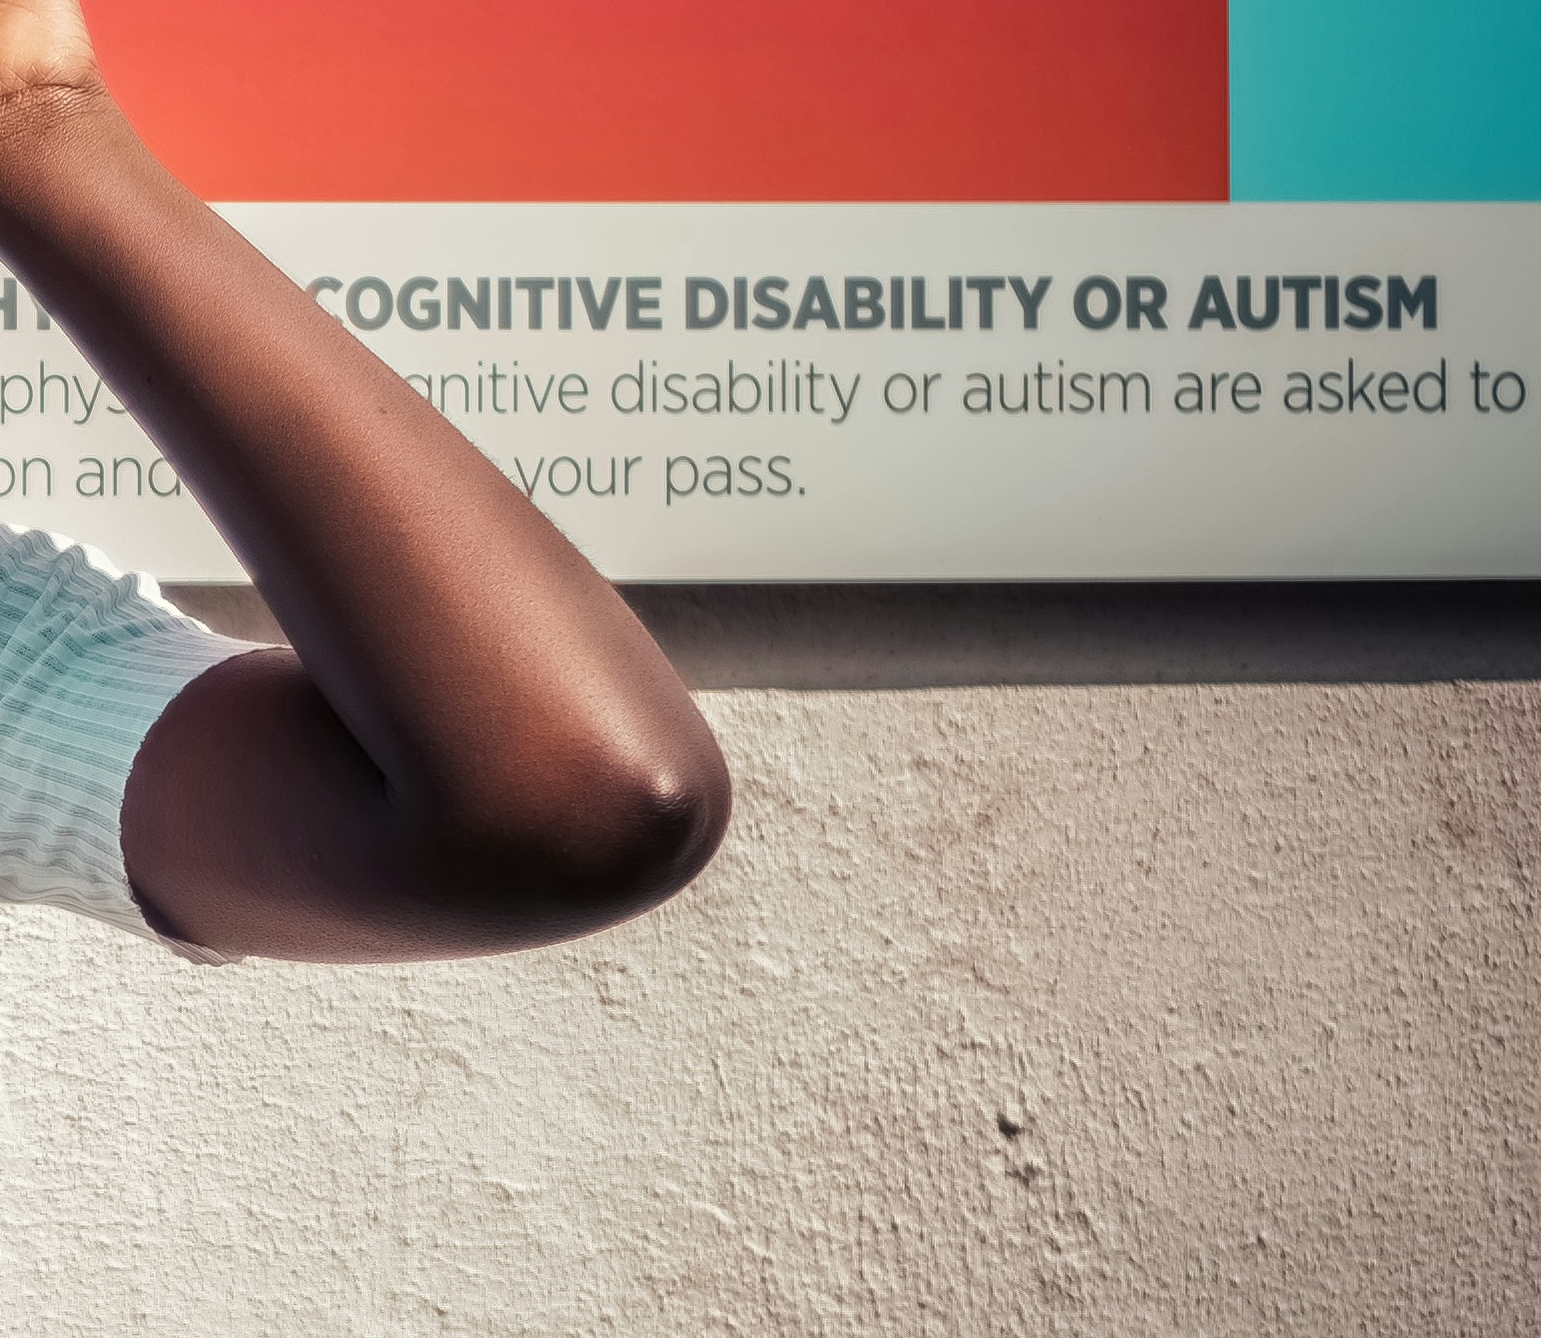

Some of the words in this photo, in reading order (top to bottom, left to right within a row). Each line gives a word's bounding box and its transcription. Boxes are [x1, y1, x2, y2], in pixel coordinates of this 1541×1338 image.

[685, 275, 1054, 331] DISABILITY
[1072, 274, 1169, 331] OR
[1188, 274, 1438, 331] AUTISM
[610, 358, 861, 425] disability
[882, 369, 943, 415] or
[961, 358, 1153, 415] autism
[1172, 368, 1263, 415] are
[1283, 356, 1448, 415] asked
[1469, 359, 1527, 415] to
[664, 453, 808, 507] pass.
